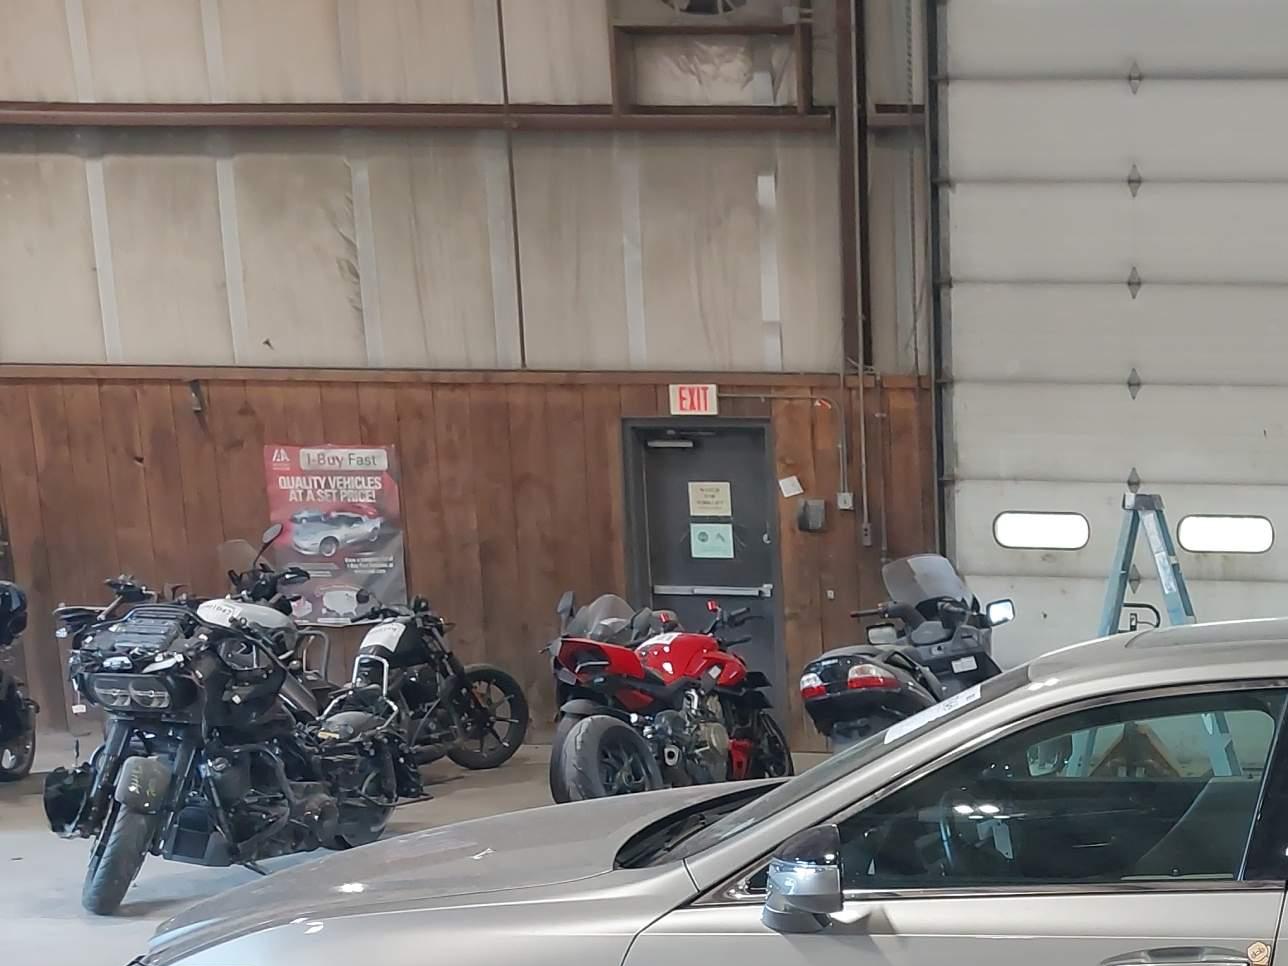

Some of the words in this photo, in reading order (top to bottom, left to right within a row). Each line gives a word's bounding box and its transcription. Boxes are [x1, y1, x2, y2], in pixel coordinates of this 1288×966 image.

[679, 386, 709, 411] EXIT
[348, 452, 377, 466] Fast
[278, 476, 327, 490] QUALITY
[328, 476, 382, 490] VEHICLES
[288, 490, 305, 503] AT
[306, 490, 316, 503] A
[317, 490, 338, 503] SET
[340, 490, 376, 503] PRICE!
